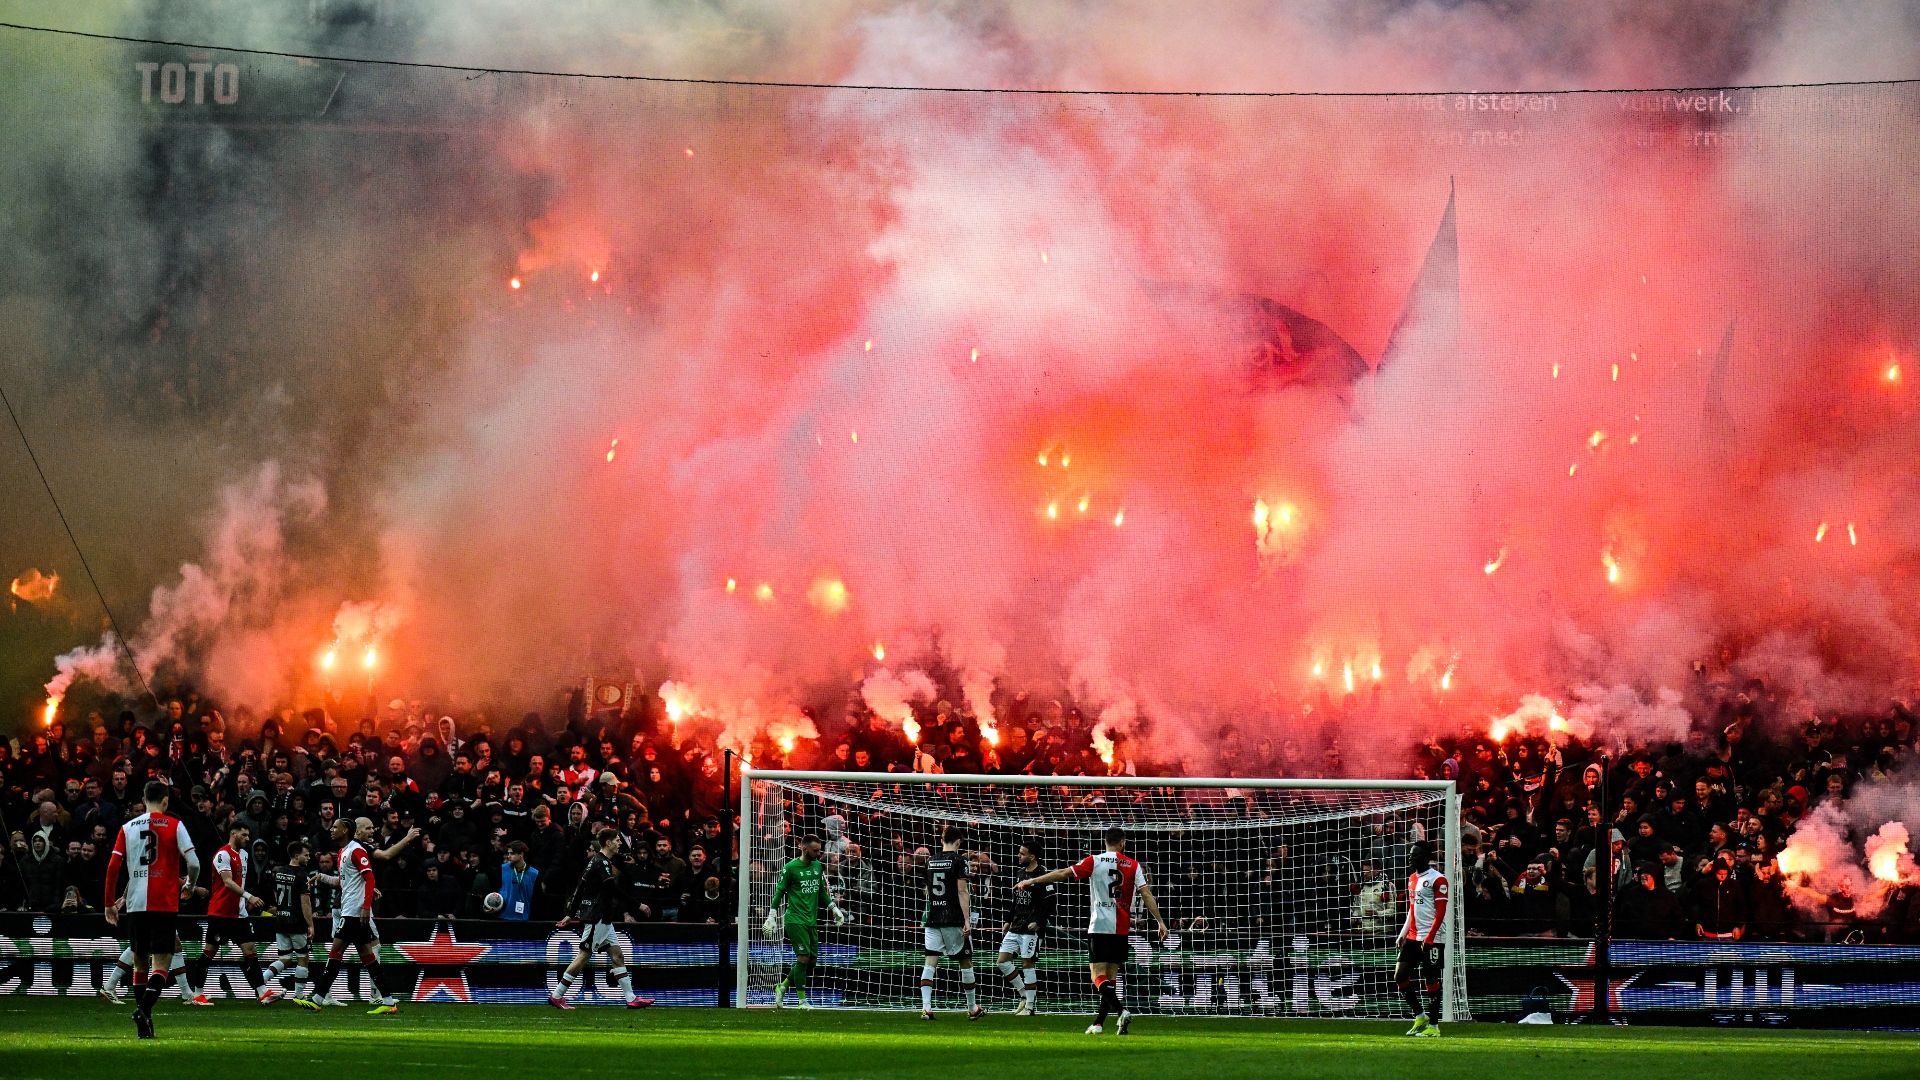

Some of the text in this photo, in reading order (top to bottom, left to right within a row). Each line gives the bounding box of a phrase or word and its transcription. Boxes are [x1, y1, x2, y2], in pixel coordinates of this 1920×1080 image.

[136, 62, 239, 104] TOTO
[140, 830, 159, 866] 3
[276, 883, 292, 907] 71
[932, 872, 946, 896] 5
[1108, 869, 1124, 898] 2
